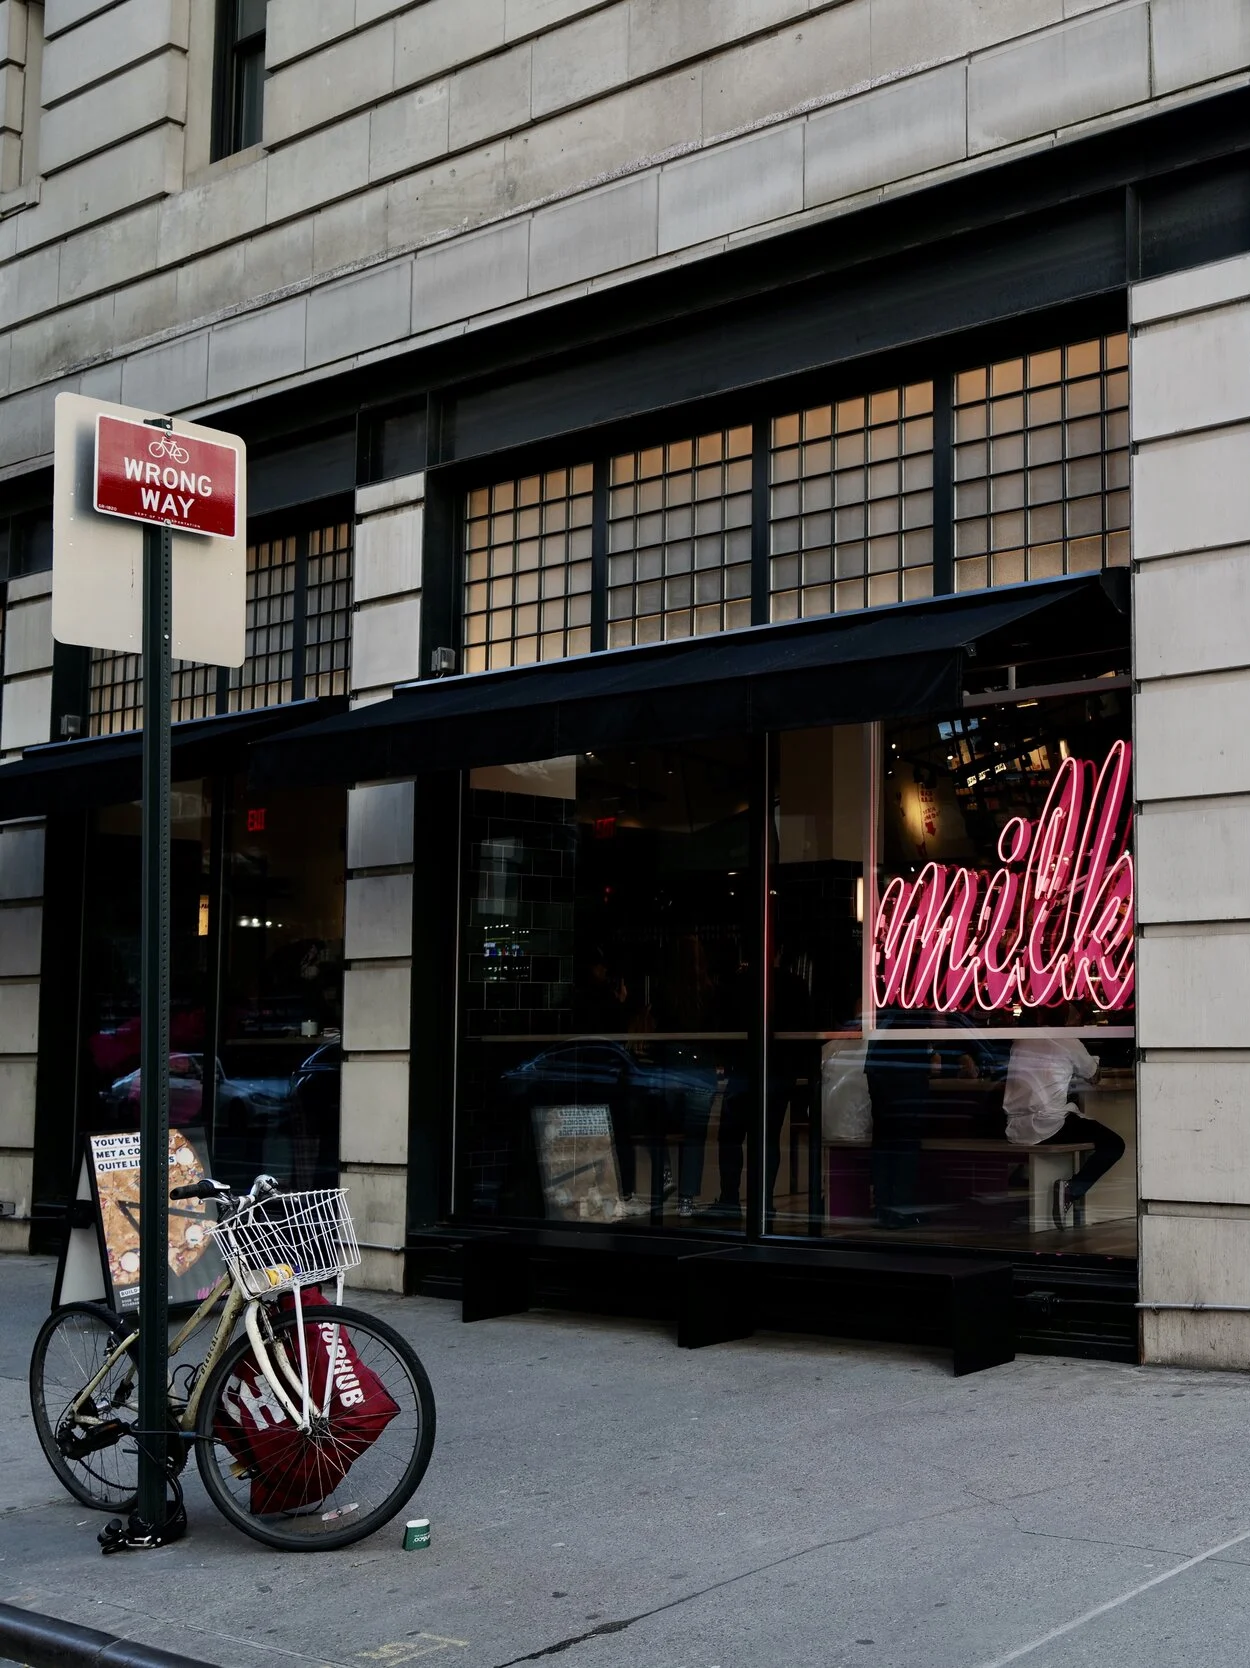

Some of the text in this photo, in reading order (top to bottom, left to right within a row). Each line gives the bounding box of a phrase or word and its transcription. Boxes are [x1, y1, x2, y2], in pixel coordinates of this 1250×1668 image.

[124, 457, 212, 497] WRONG
[141, 487, 195, 518] WAY
[872, 739, 1134, 1012] milk
[94, 1137, 131, 1146] YOU'VE
[96, 1150, 116, 1158] MET
[98, 1161, 127, 1171] QUITE
